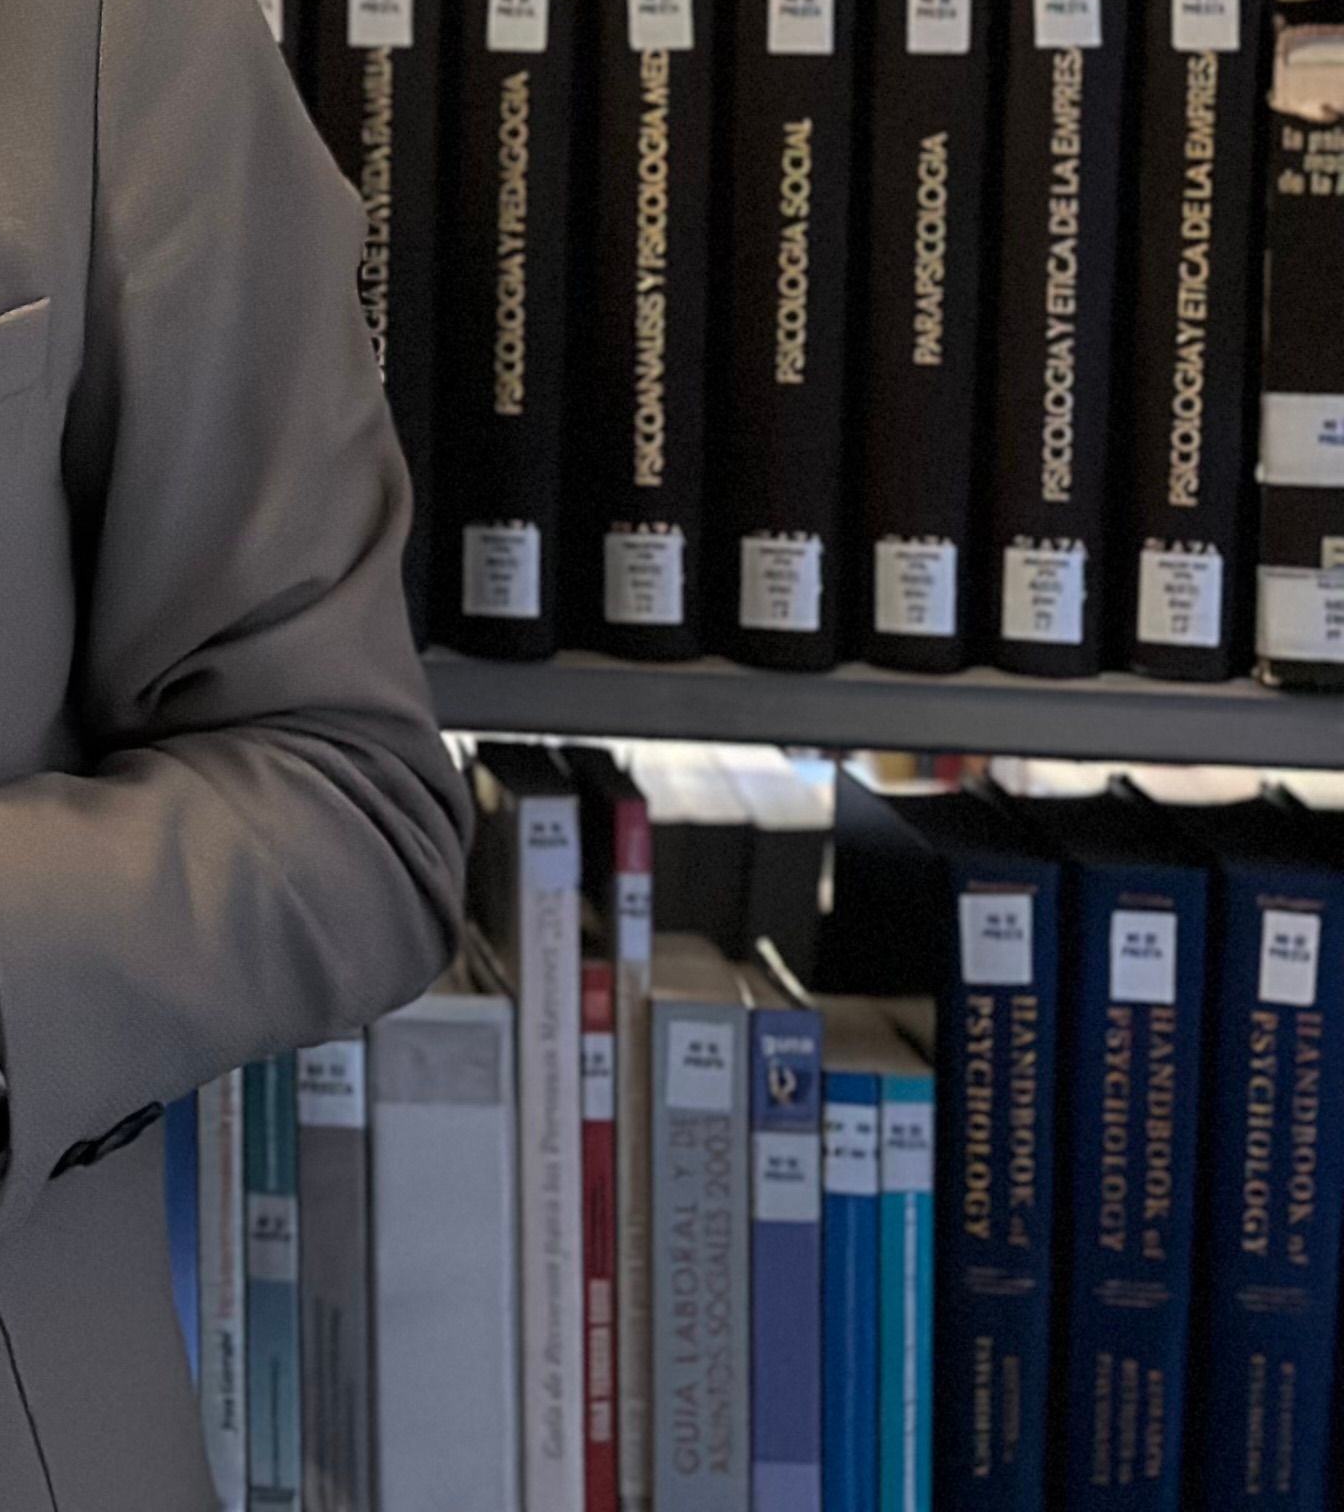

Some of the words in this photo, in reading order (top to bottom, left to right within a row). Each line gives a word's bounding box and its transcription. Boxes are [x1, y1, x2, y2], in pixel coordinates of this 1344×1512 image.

[498, 71, 529, 232] PEDAGOGIA
[637, 108, 669, 268] PSICOLOGIA
[779, 117, 812, 217] SOCIAL
[1049, 196, 1079, 234] DE
[1050, 159, 1080, 194] LA
[1179, 201, 1213, 239] DE
[1181, 163, 1214, 199] LA
[496, 235, 526, 256] Y
[637, 270, 666, 293] Y
[776, 222, 809, 384] PSICOLOGIA
[912, 133, 949, 365] PARAPSICOLOGIA
[1046, 239, 1078, 315] ETICA
[1176, 243, 1210, 320] ETICA
[495, 254, 525, 415] PSICOLOGIA
[635, 294, 665, 486] PSICOANALISIS
[1045, 315, 1075, 339] Y
[1175, 320, 1206, 344] Y
[1043, 339, 1077, 502] PSICOLOGIA
[1169, 343, 1206, 507] PSICOLOGIA
[964, 994, 996, 1239] PSYCHOLOGY
[1008, 994, 1038, 1208] HANDBOOK
[1099, 1005, 1135, 1252] PSYCHOLOGY
[1144, 1006, 1176, 1220] HANDBOOK
[1241, 1010, 1280, 1256] PSYCHOLOGY
[1287, 1010, 1324, 1226] HANDBOOK
[670, 1204, 699, 1365] LABORAL
[670, 1382, 701, 1476] GUIA
